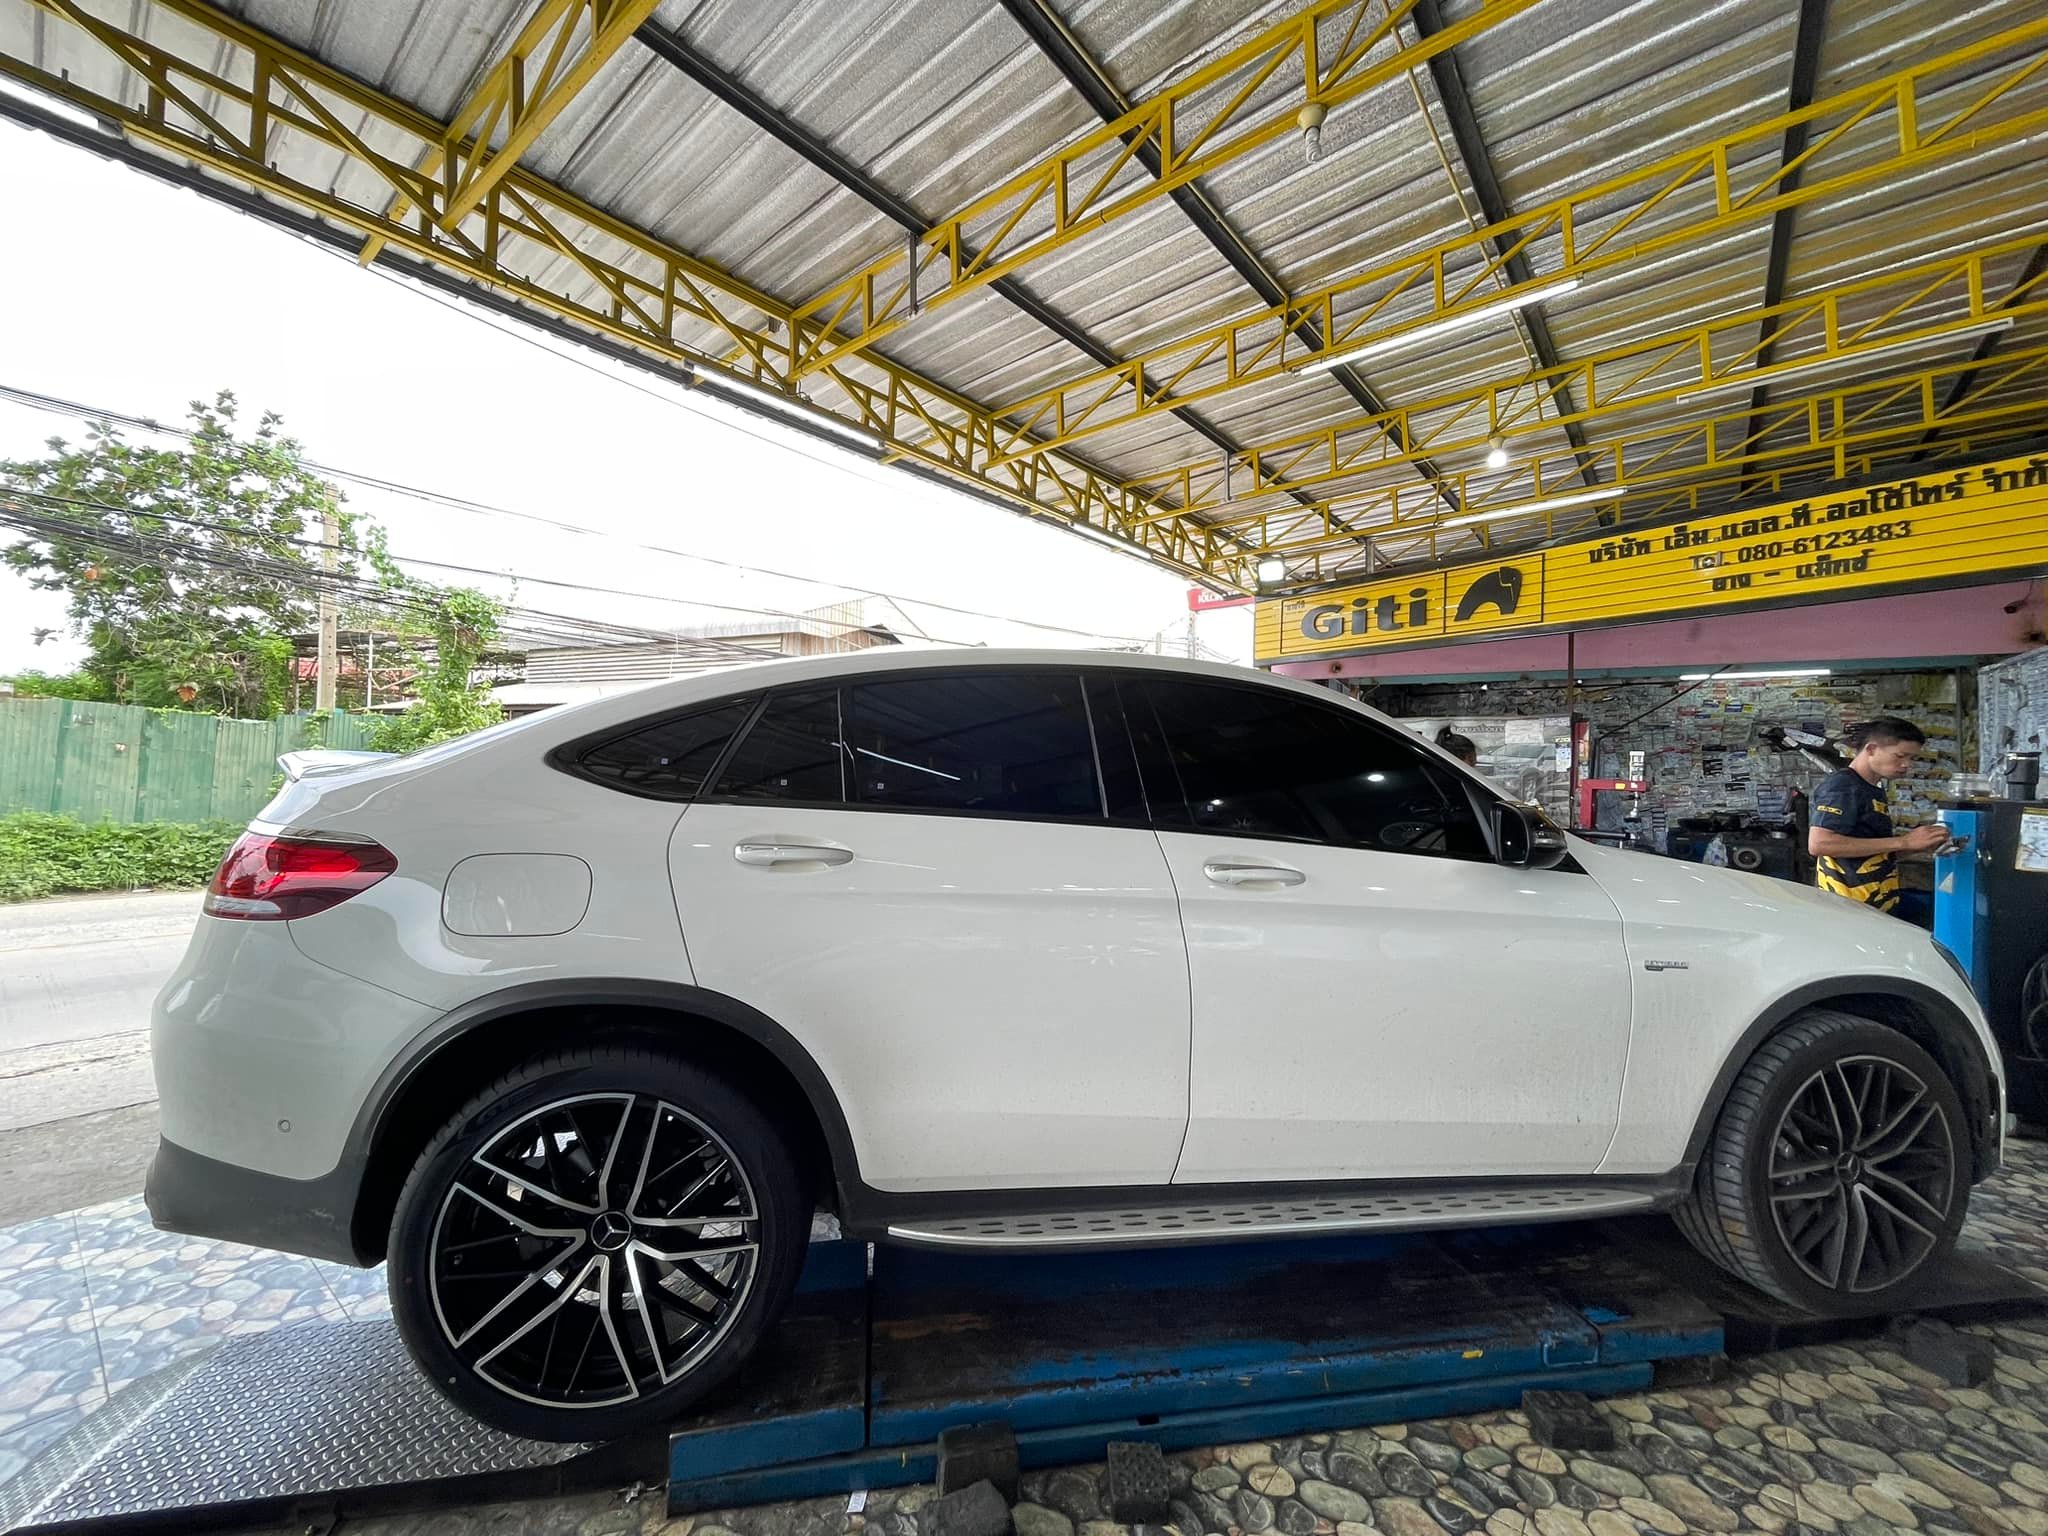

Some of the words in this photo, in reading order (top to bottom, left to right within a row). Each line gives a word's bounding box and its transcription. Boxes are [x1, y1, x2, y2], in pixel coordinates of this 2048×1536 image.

[1589, 537, 1650, 563] บริษัท
[1982, 458, 2048, 492] จำกั
[1689, 551, 1730, 570] Tel.
[1737, 520, 1911, 563] 080-6123483
[1301, 587, 1429, 640] Giti
